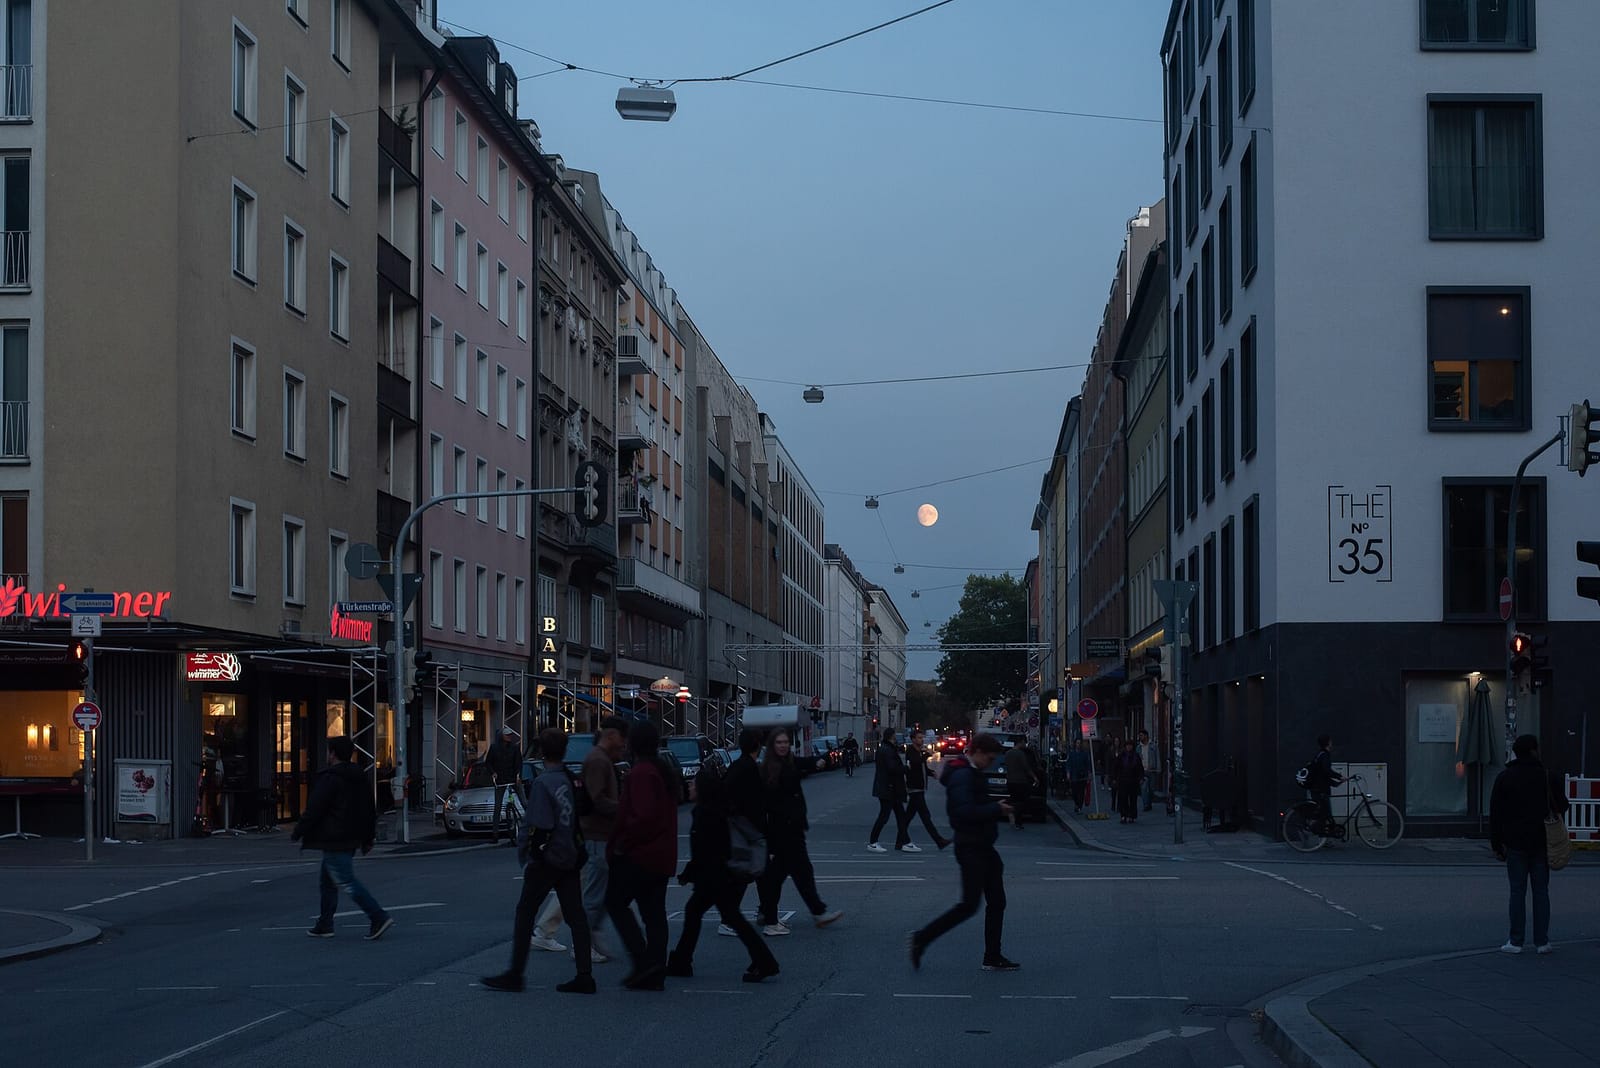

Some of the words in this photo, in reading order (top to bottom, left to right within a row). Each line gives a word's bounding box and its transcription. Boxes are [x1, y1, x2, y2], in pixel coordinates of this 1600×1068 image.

[1335, 493, 1384, 518] THE
[1338, 538, 1384, 575] 35
[338, 612, 373, 642] wimmer
[542, 616, 557, 674] BAR
[187, 669, 220, 679] wimmer
